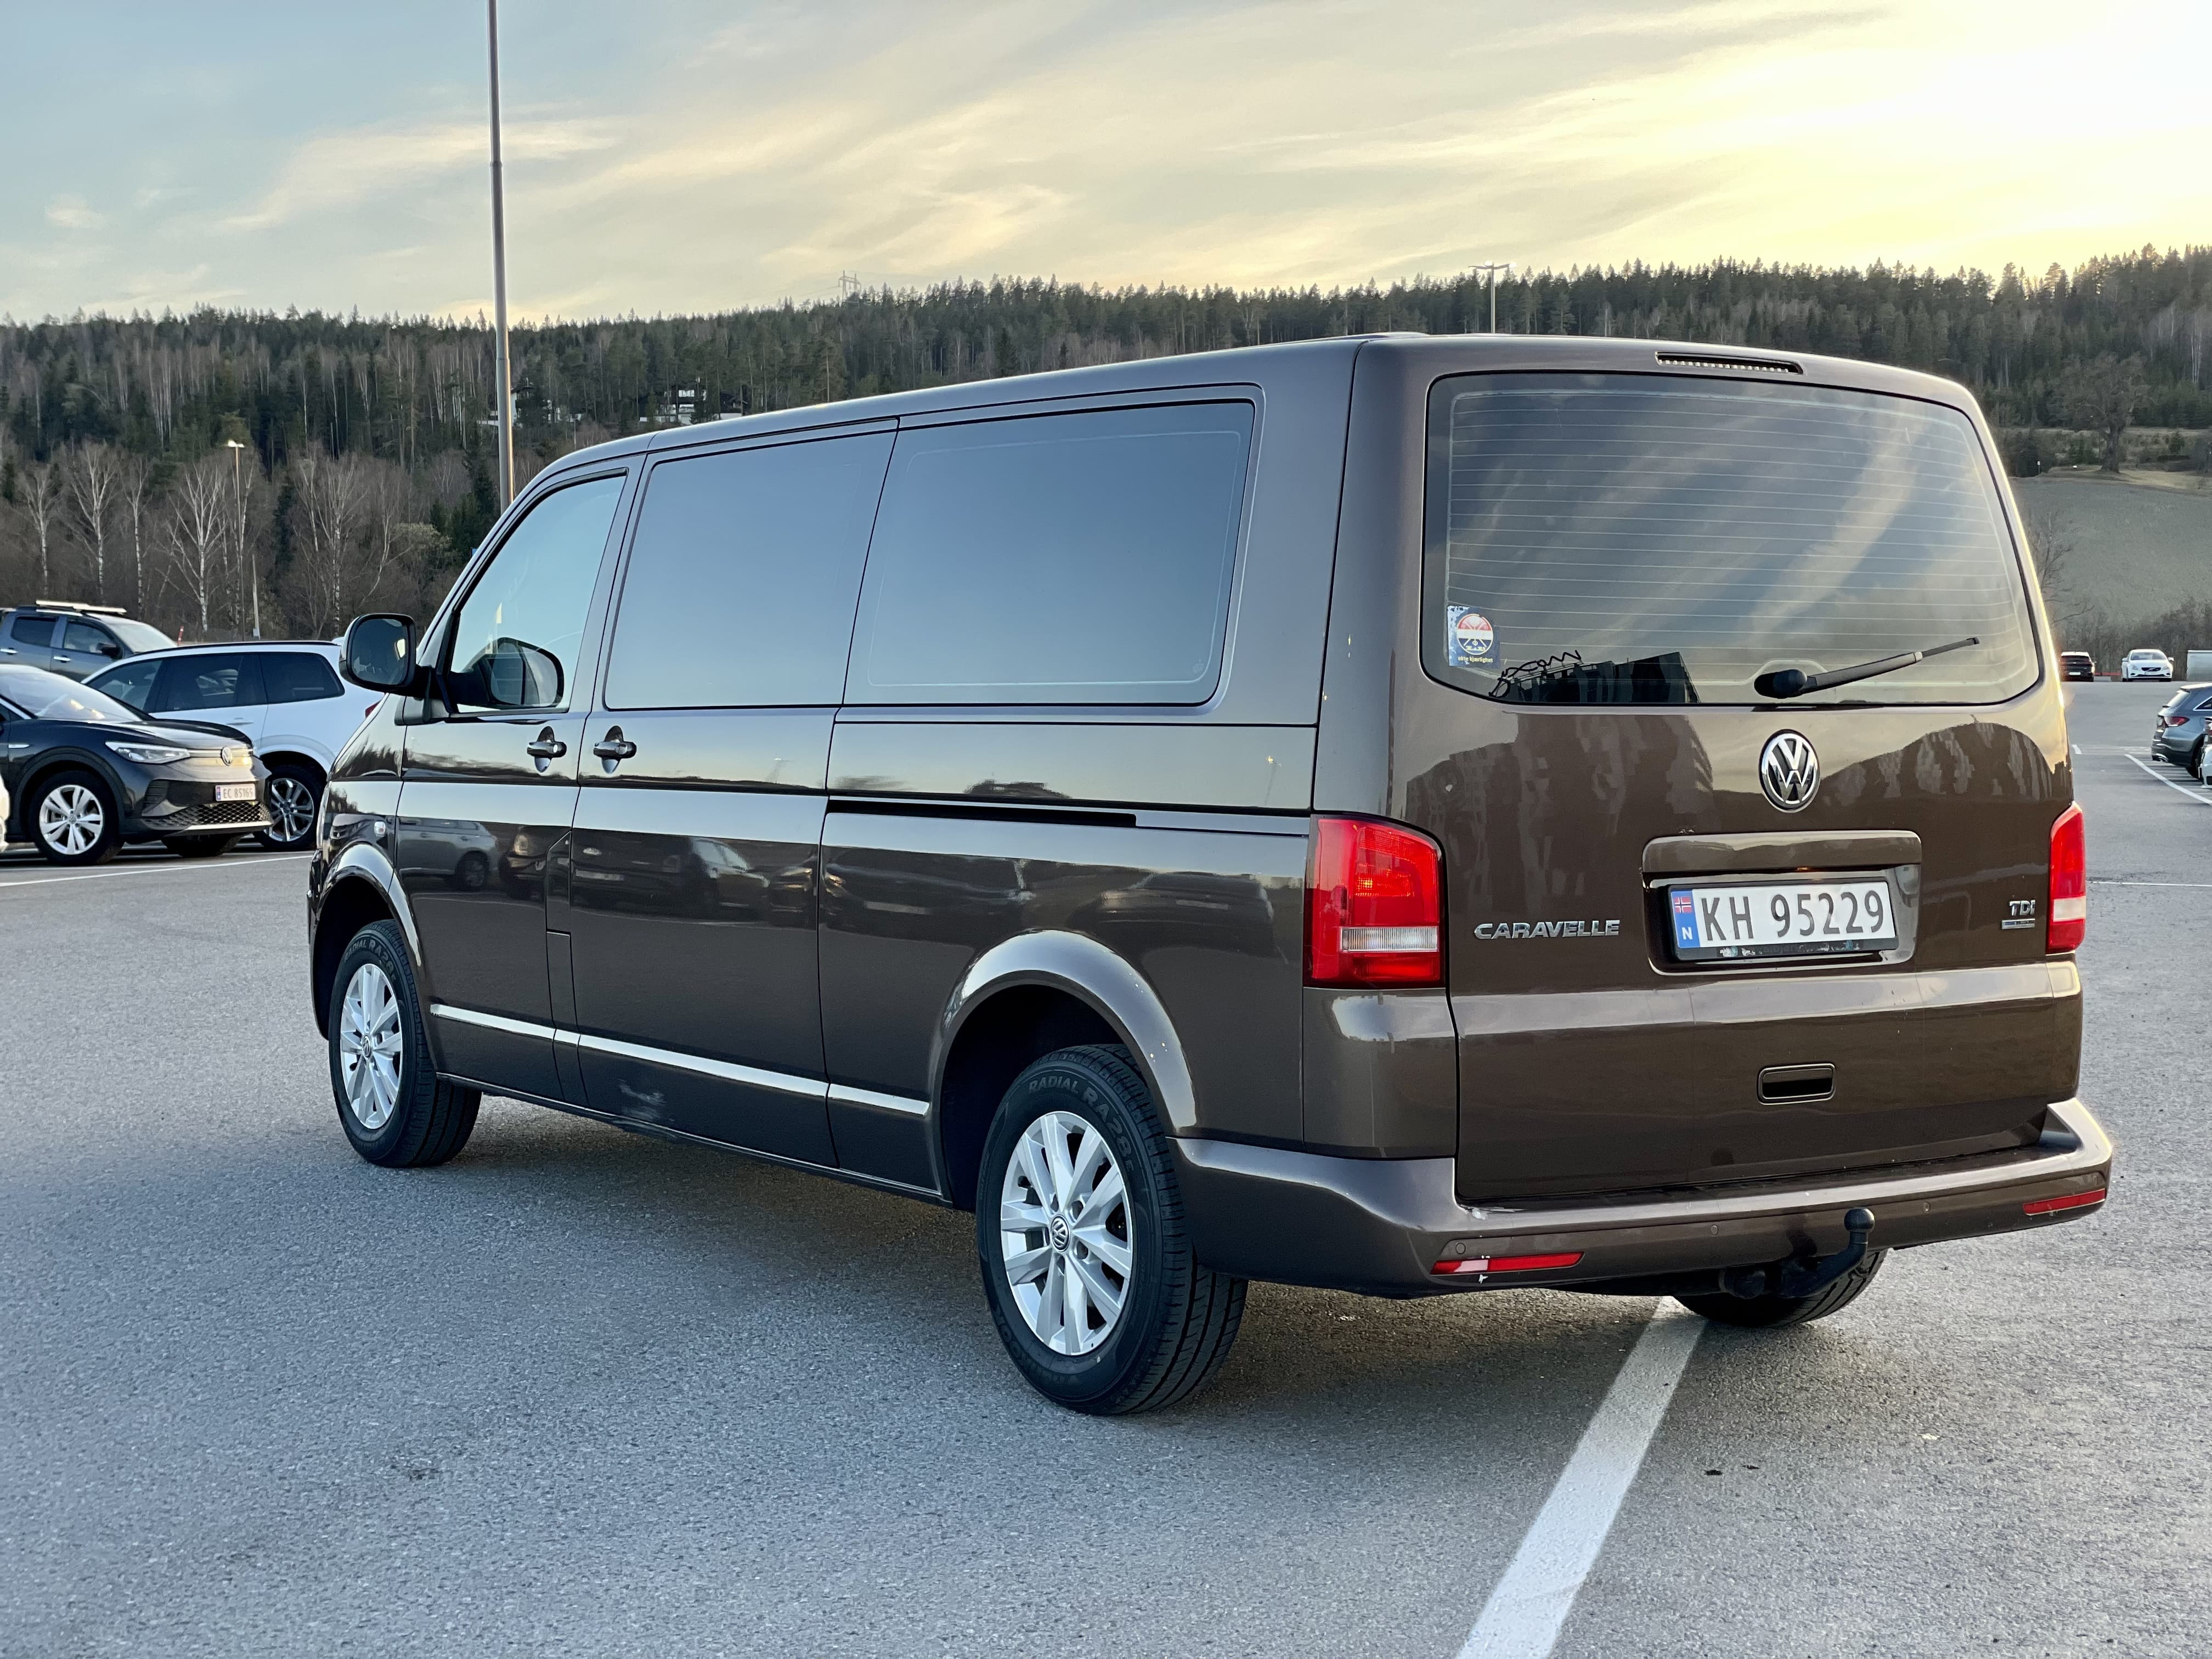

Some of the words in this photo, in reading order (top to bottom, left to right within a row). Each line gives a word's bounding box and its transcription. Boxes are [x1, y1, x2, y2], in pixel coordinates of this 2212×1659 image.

[223, 789, 232, 799] EC
[1701, 896, 1754, 941] KH
[1770, 890, 1884, 938] 95229
[2009, 900, 2036, 916] TDI
[1474, 919, 1621, 940] CARAVELLE
[1682, 927, 1693, 940] N
[1028, 1075, 1080, 1094] RADIAL
